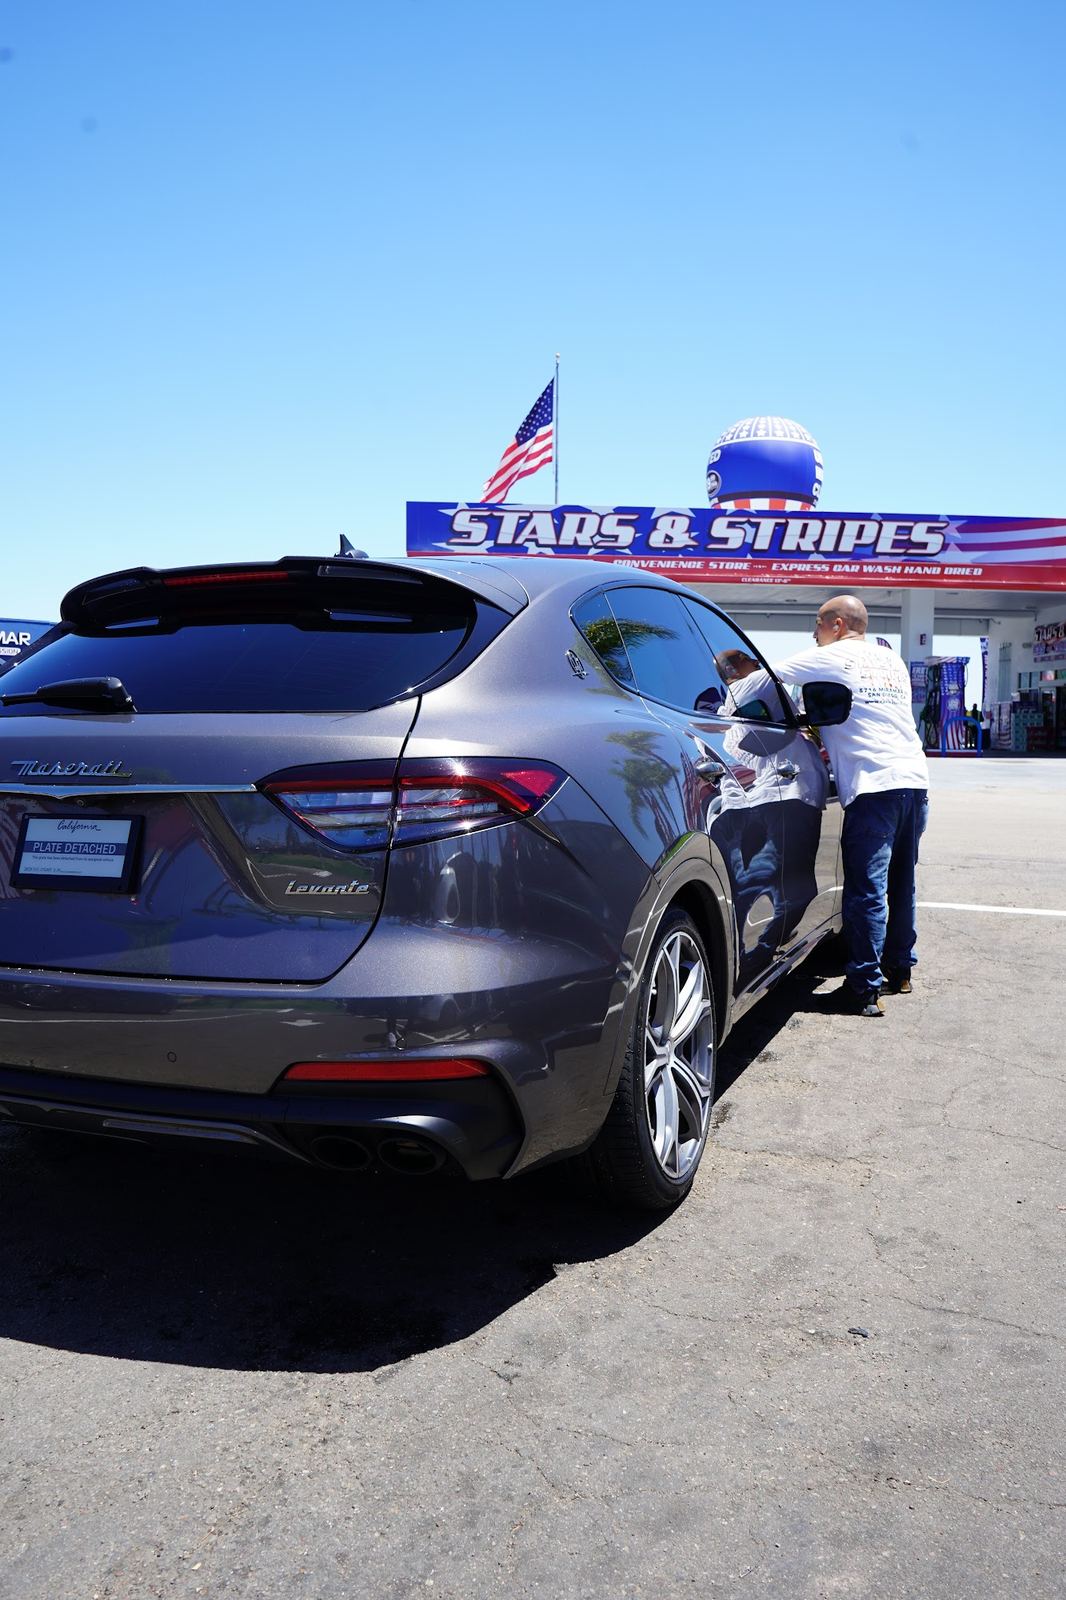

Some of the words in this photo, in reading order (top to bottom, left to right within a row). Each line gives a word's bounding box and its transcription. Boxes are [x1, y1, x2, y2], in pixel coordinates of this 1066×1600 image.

[446, 509, 640, 548] STARS
[648, 514, 699, 548] &
[705, 516, 949, 556] STRIPES
[708, 561, 751, 570] STORE
[771, 562, 830, 572] EXPRESS
[832, 564, 860, 573] CAR
[863, 565, 902, 574] WASH
[903, 566, 941, 575] HAND
[943, 567, 983, 576] DRIED
[11, 760, 132, 778] Maserati
[57, 819, 102, 833] California
[33, 842, 62, 853] PLATE
[64, 843, 117, 854] DETACHED
[285, 880, 370, 895] Levante
